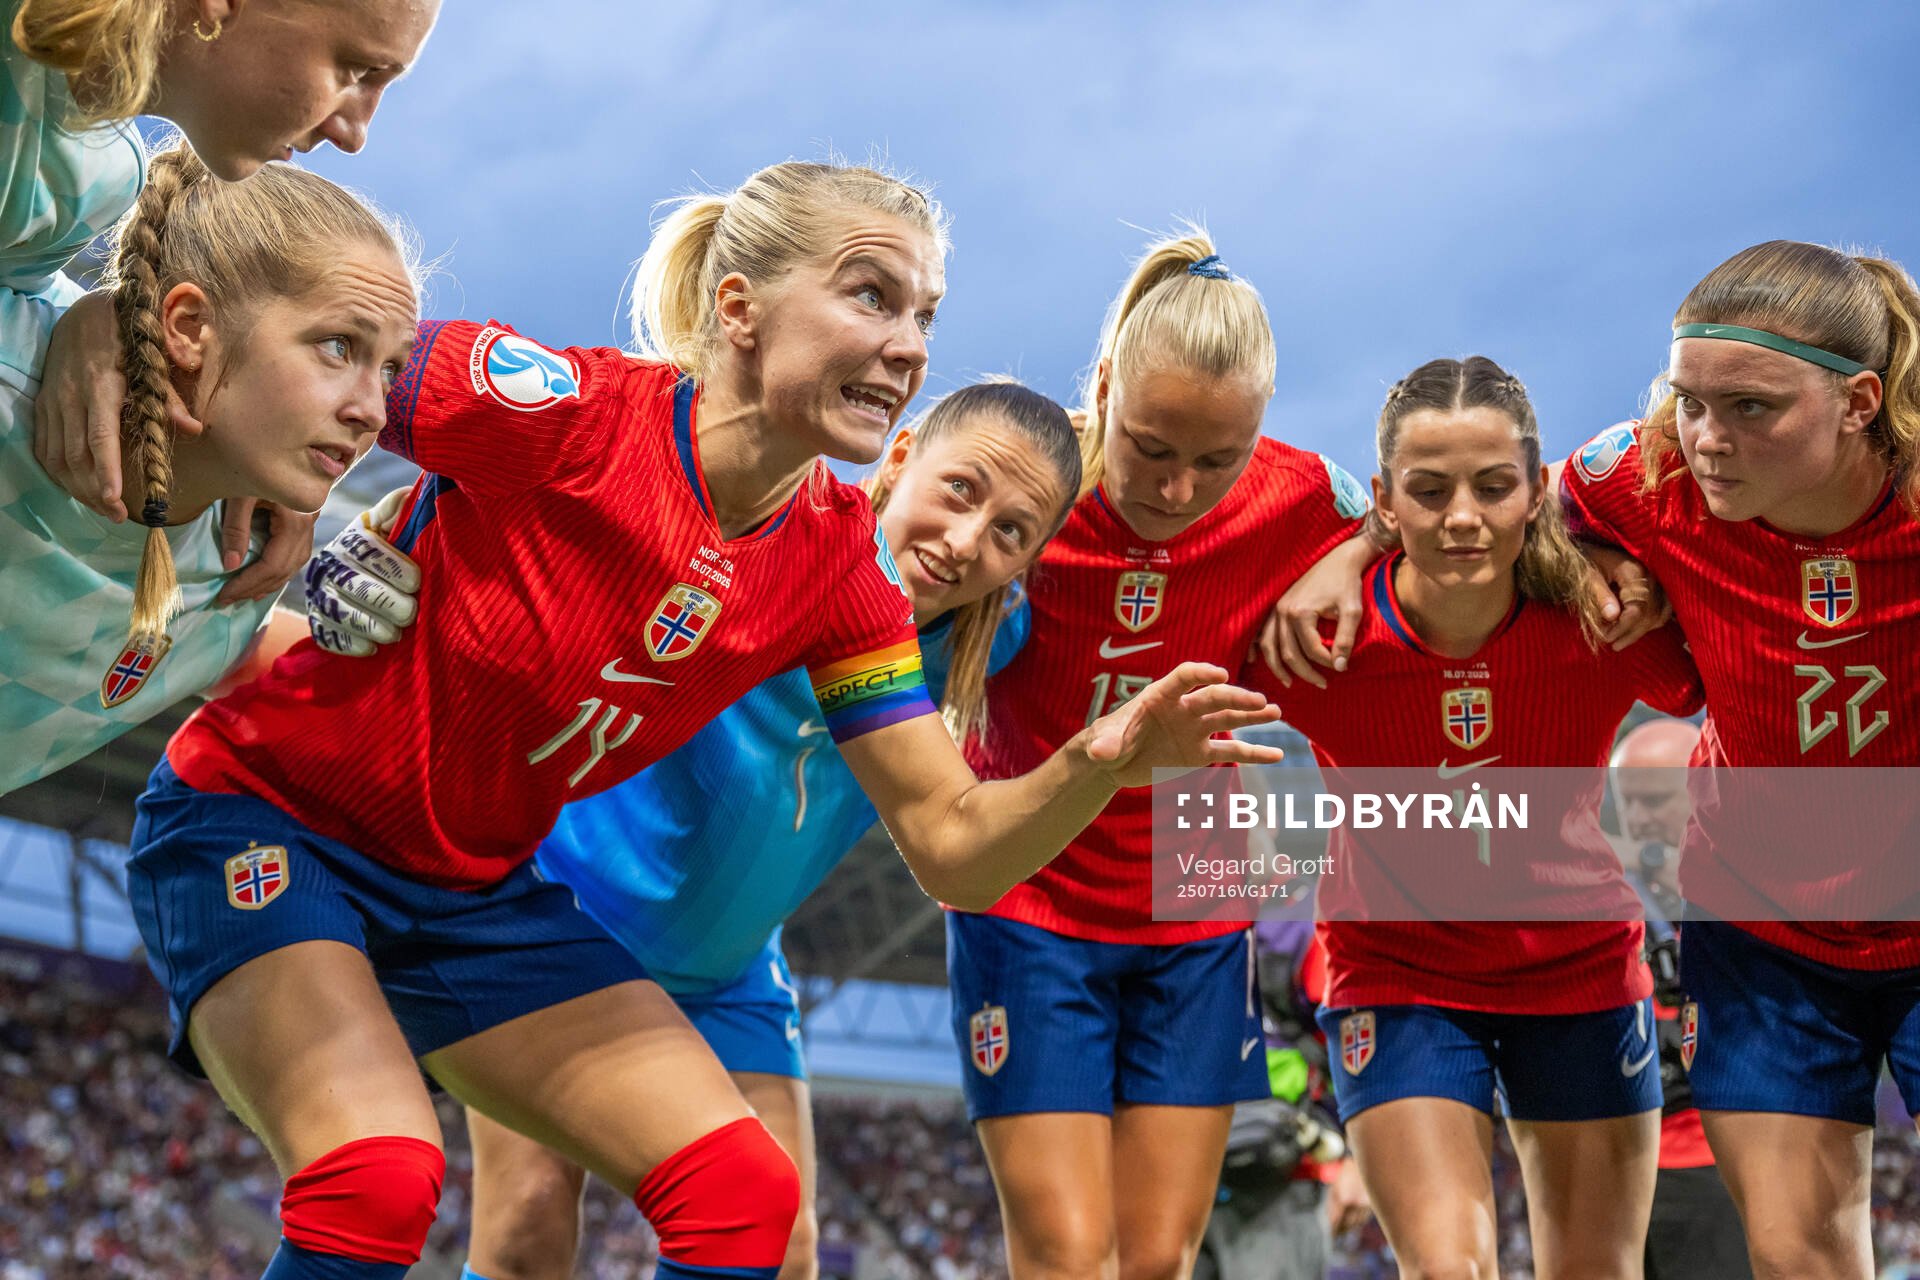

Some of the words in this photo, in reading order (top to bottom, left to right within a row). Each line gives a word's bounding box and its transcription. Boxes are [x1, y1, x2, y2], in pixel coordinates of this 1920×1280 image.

[473, 369, 486, 390] 2025
[689, 557, 732, 589] 16.07.2025
[1794, 665, 1889, 758] 22
[527, 697, 644, 789] 14
